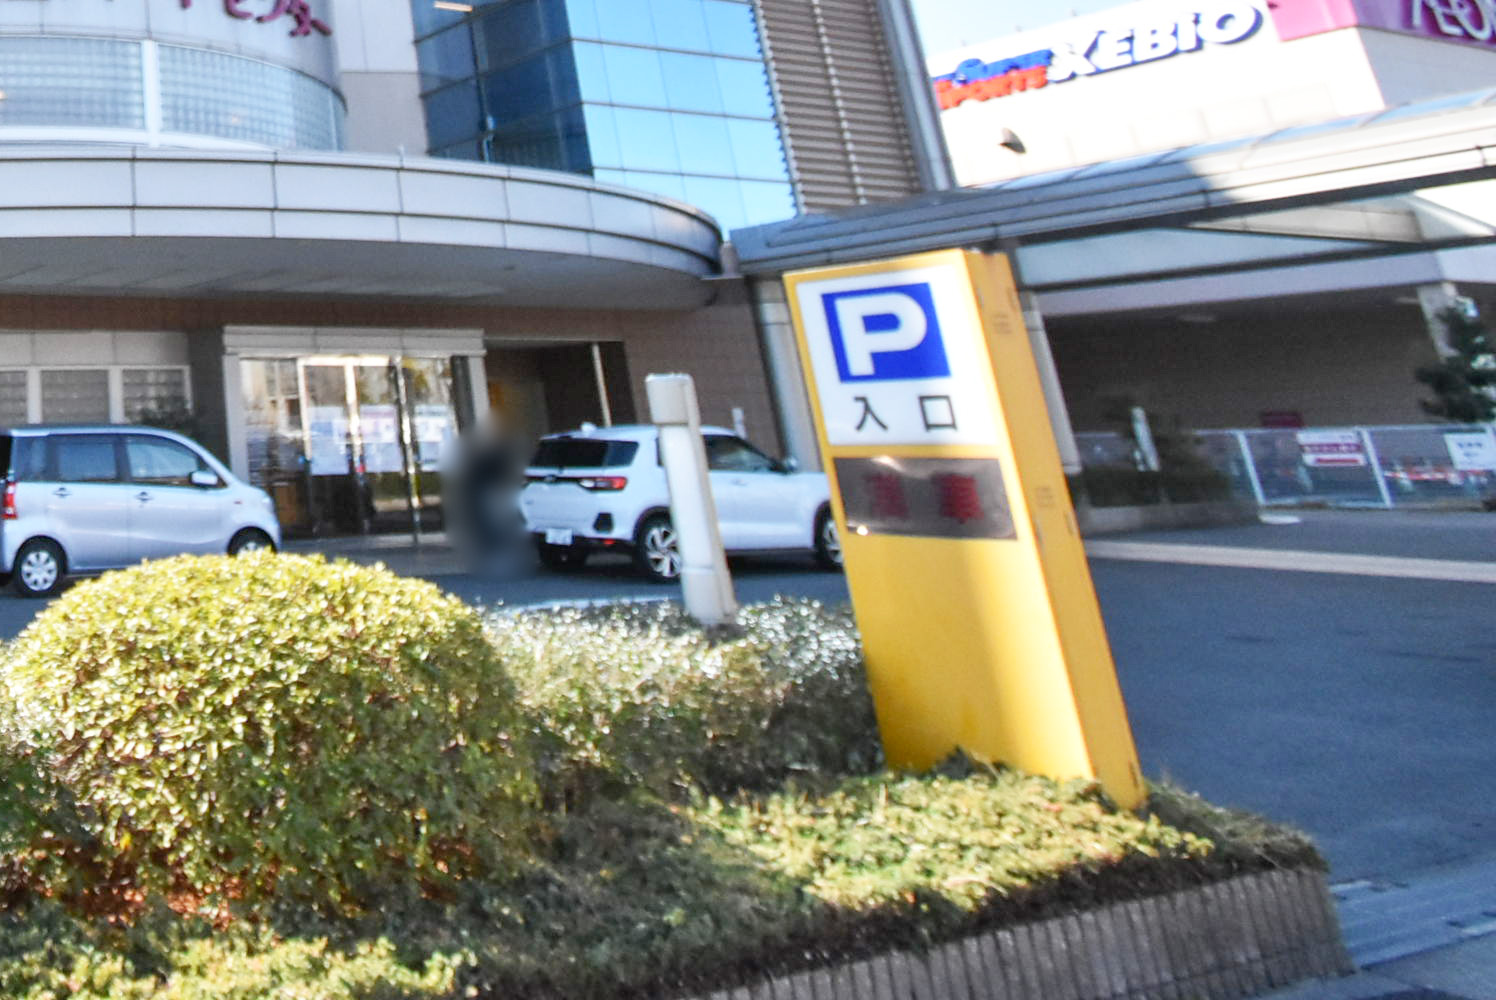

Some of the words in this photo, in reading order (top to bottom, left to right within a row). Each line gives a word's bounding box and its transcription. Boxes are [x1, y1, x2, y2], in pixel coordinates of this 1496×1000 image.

[1047, 4, 1265, 84] XEBIO
[834, 292, 928, 377] P
[853, 394, 958, 433] 入口
